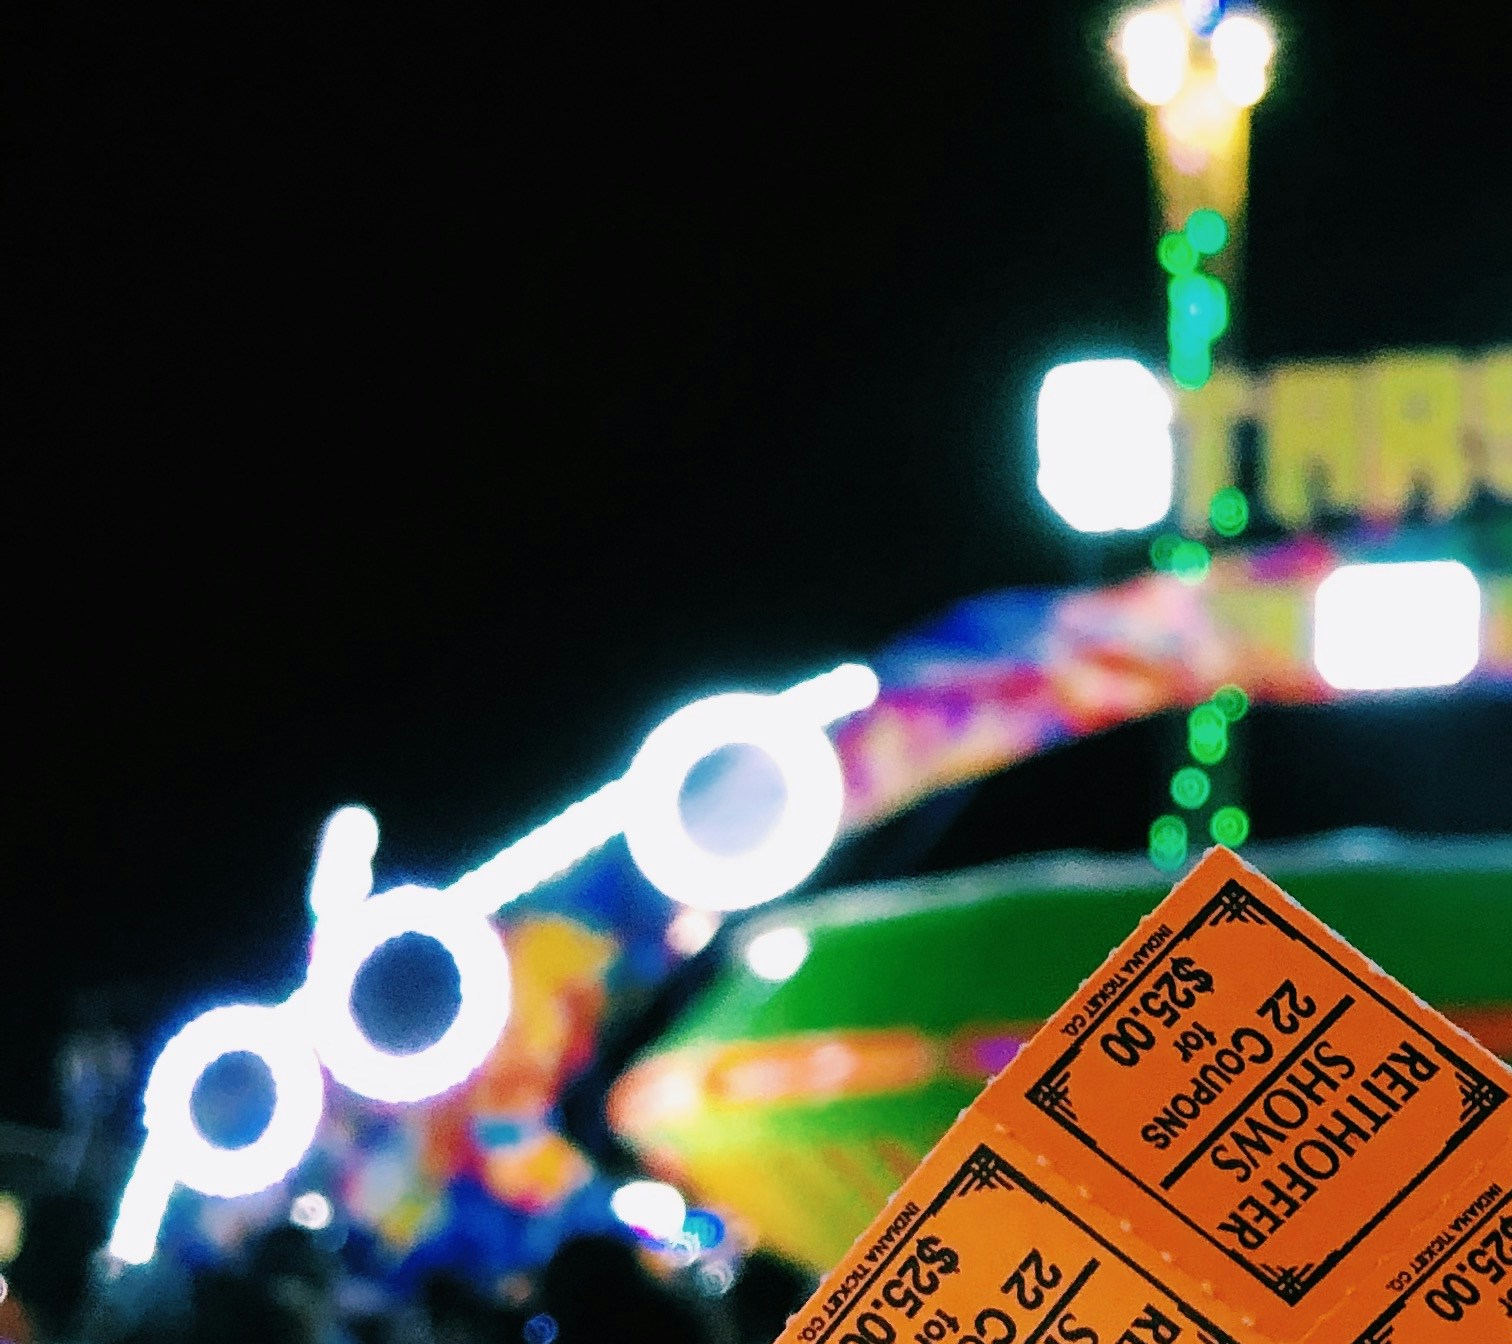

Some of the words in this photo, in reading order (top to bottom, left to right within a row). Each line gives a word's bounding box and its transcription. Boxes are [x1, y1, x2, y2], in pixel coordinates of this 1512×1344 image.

[1119, 923, 1174, 975] INDIANA
[1082, 973, 1129, 1019] TICKET
[1099, 956, 1215, 1068] $25.00
[1255, 978, 1317, 1035] 22
[1172, 1020, 1218, 1064] for
[1140, 1027, 1274, 1151] COUPONS
[1210, 1040, 1356, 1183] SHOWS
[1216, 1040, 1441, 1251] REITHOFFER
[864, 1201, 921, 1263] INDIANA
[1448, 1183, 1503, 1233] INDIANA
[1000, 1248, 1063, 1311] 22
[1409, 1231, 1456, 1275] TICKET
[822, 1263, 871, 1319] TICKET
